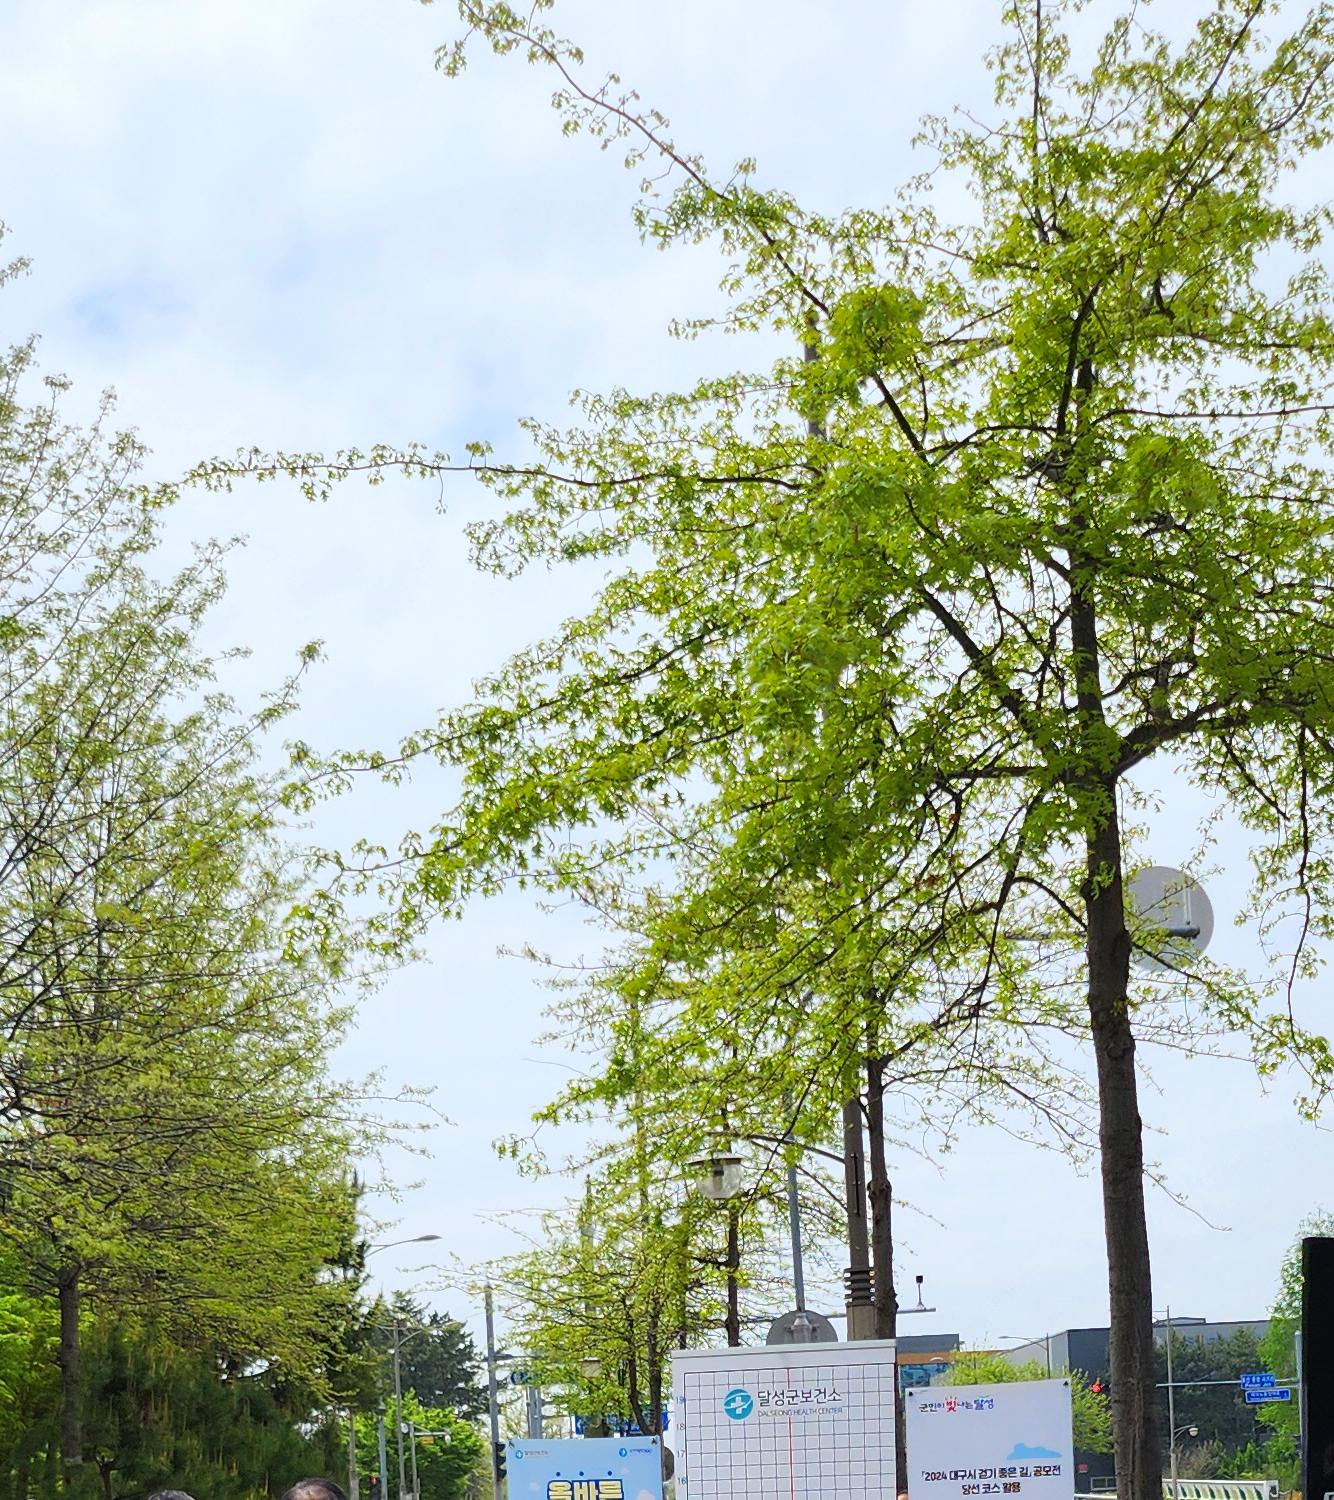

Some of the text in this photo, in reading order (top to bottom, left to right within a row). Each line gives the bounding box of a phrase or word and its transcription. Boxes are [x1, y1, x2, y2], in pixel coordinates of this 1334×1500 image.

[676, 1396, 685, 1404] 19
[757, 1387, 842, 1407] 달성군보건소
[974, 1398, 994, 1411] 달성
[758, 1407, 843, 1417] DALSEONG HEALTH CENTER
[676, 1450, 685, 1458] 17
[949, 1469, 977, 1480] 대구시
[978, 1468, 997, 1480] 걷기
[998, 1467, 1017, 1479] 좋은
[1033, 1465, 1061, 1477] 공모전
[677, 1477, 687, 1485] 16
[962, 1482, 1021, 1495] 당선 코스 활용
